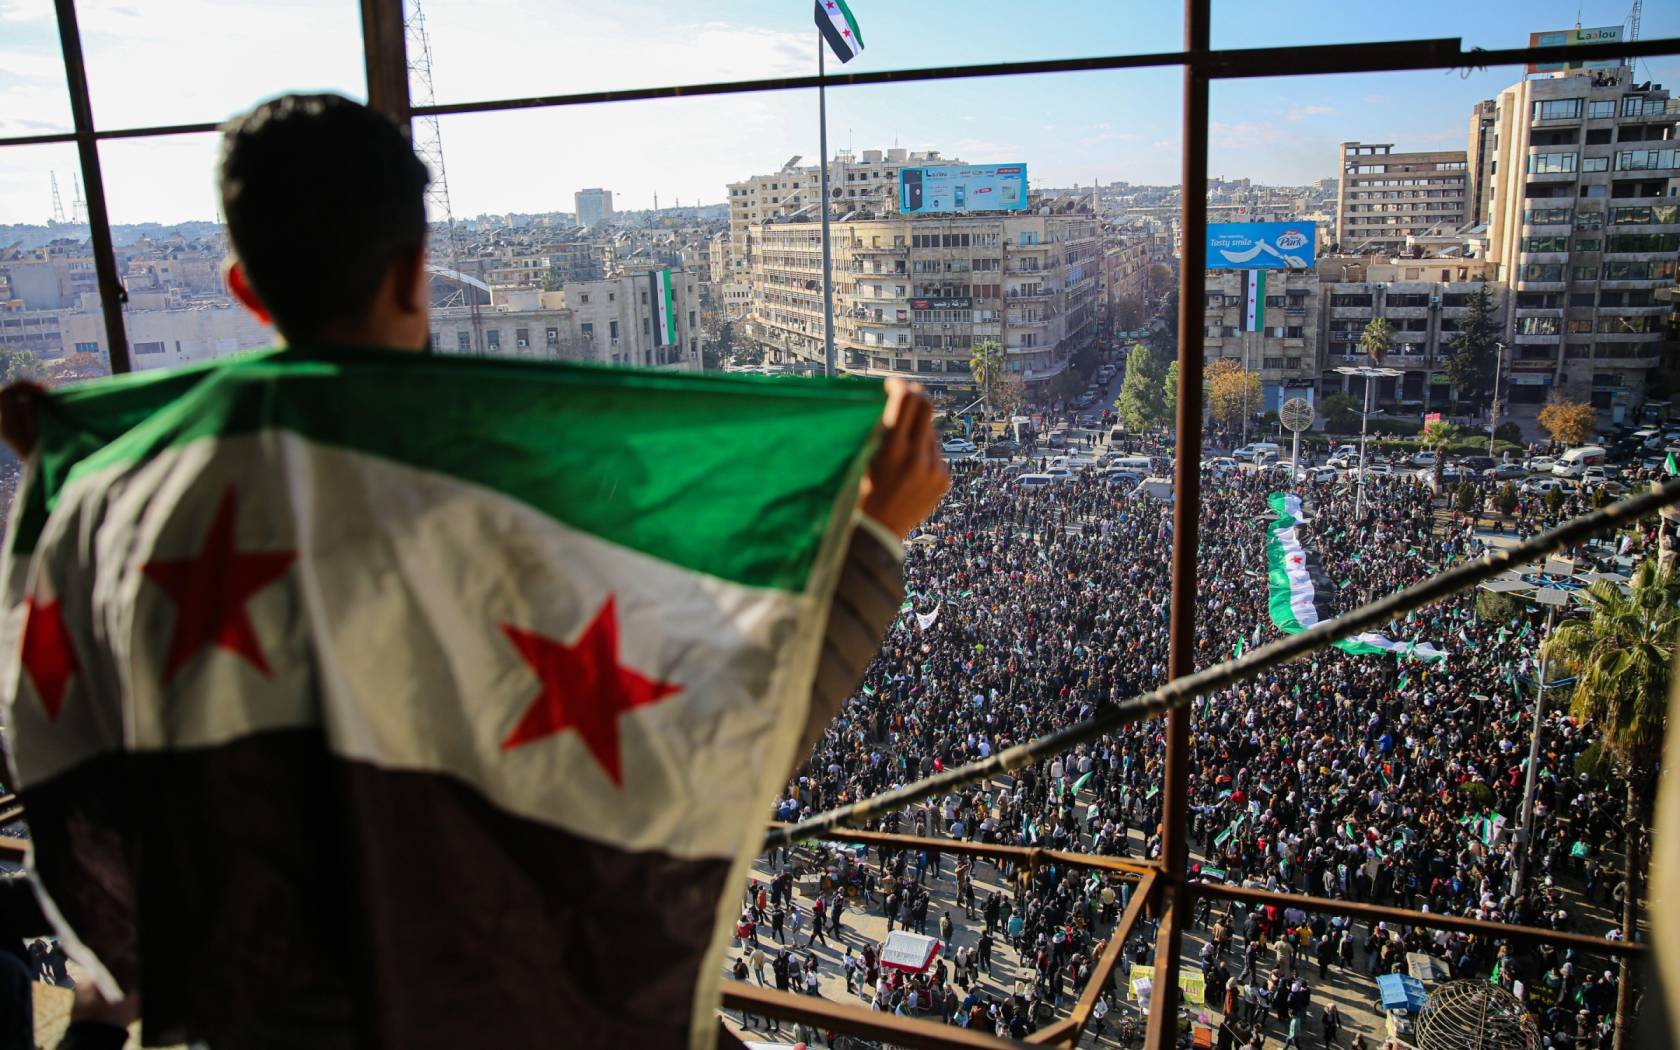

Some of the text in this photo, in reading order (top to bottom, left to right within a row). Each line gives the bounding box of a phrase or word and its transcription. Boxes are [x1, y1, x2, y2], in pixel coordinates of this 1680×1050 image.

[1577, 30, 1616, 41] Laalou
[1210, 238, 1252, 248] Tasty smile
[1279, 236, 1302, 247] Park
